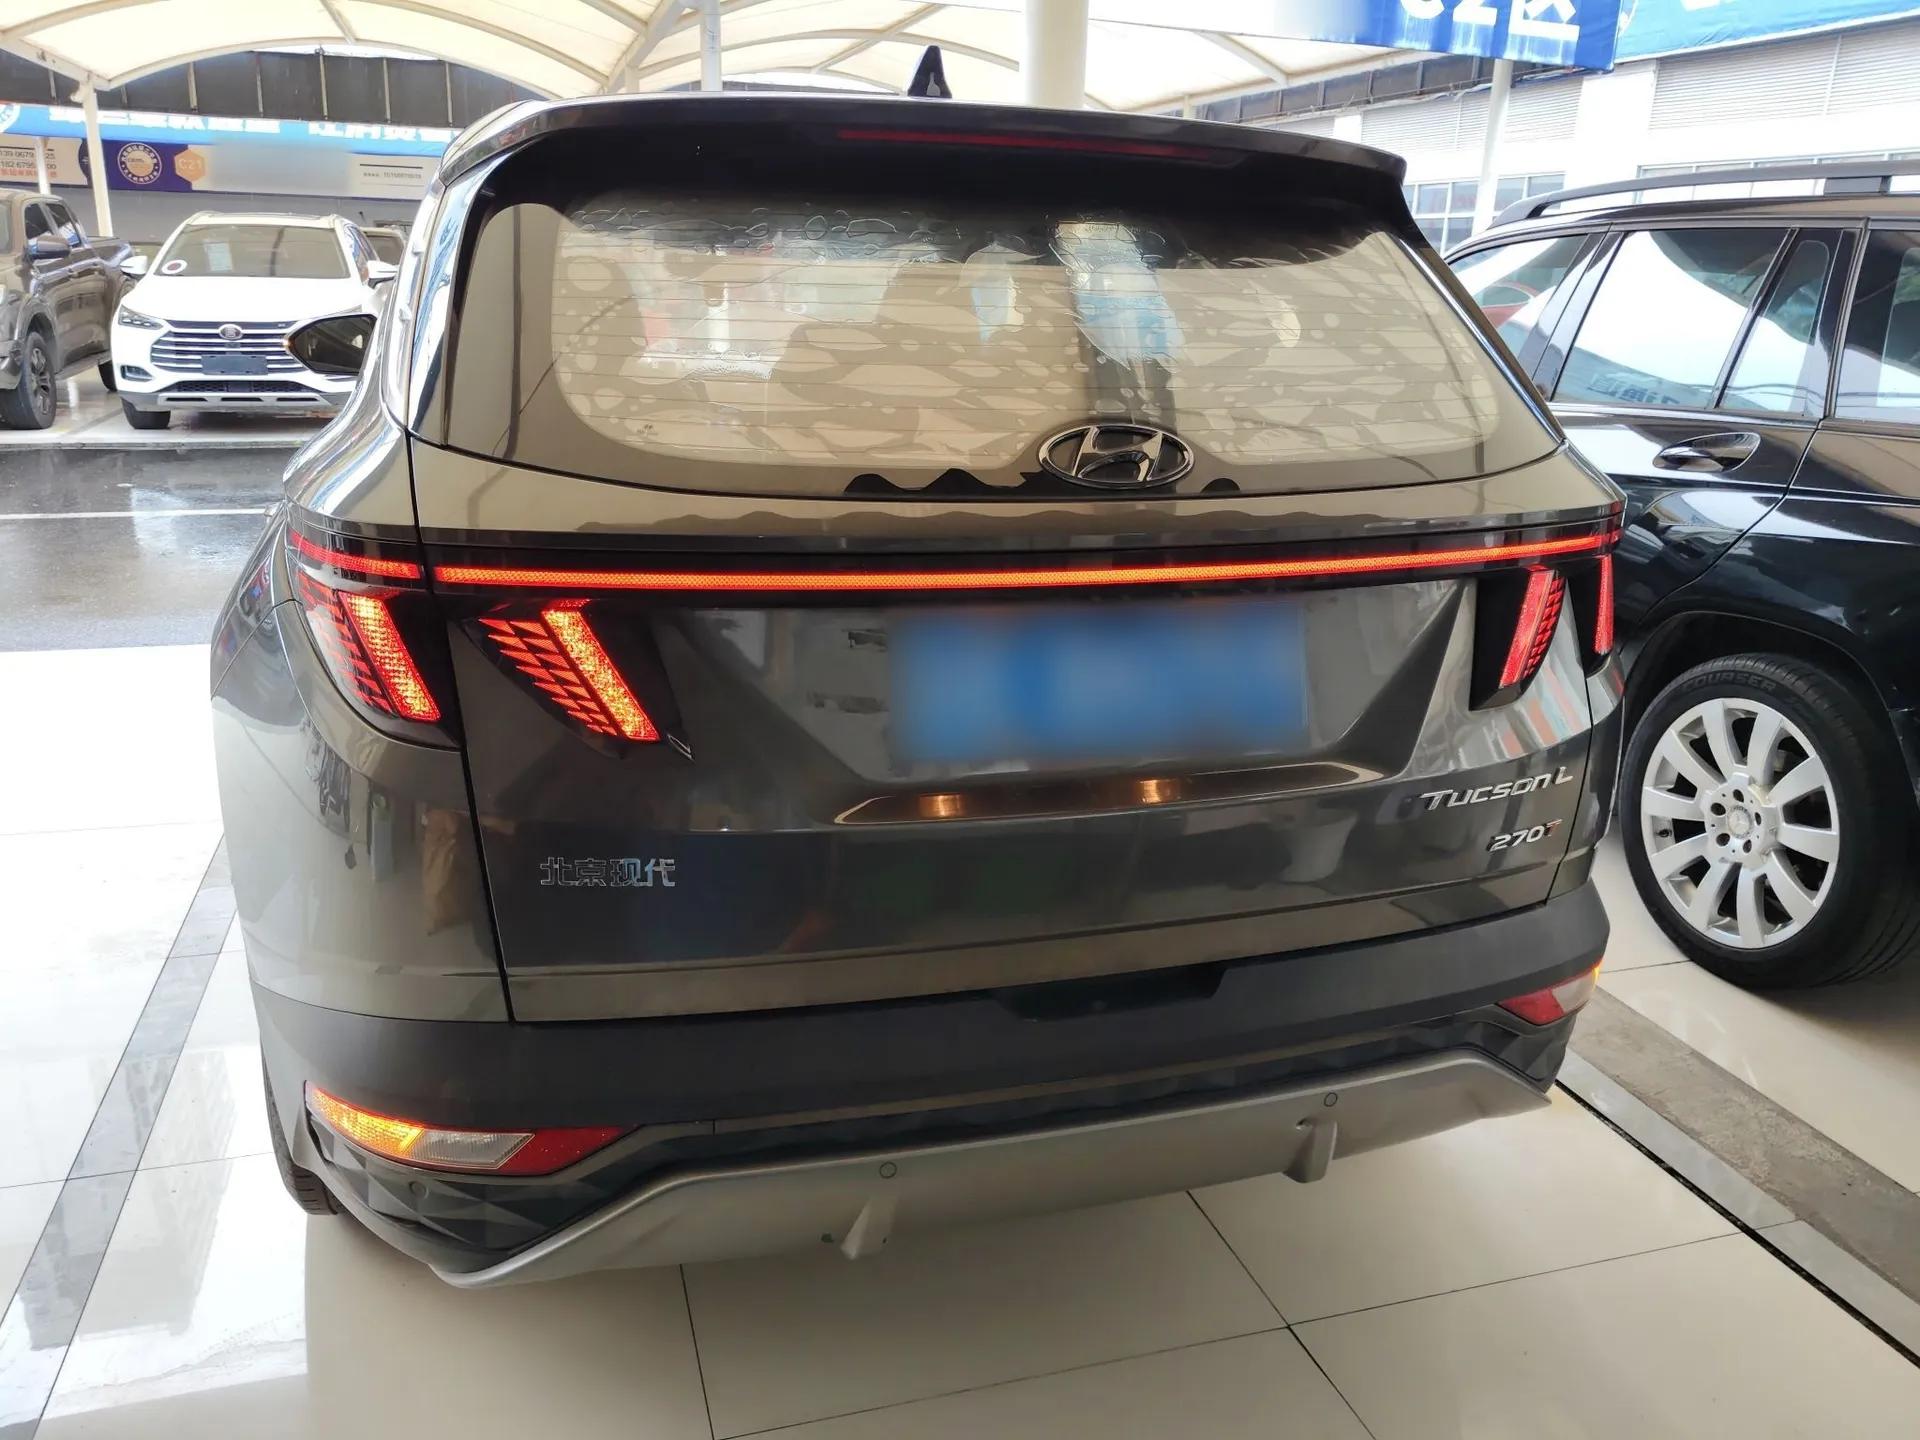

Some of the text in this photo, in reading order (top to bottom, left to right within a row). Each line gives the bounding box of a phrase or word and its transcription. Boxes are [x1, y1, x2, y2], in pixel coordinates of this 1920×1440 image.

[1419, 766, 1574, 810] TUCSON L
[1489, 819, 1563, 852] 270T
[540, 856, 676, 887] 北京现代
